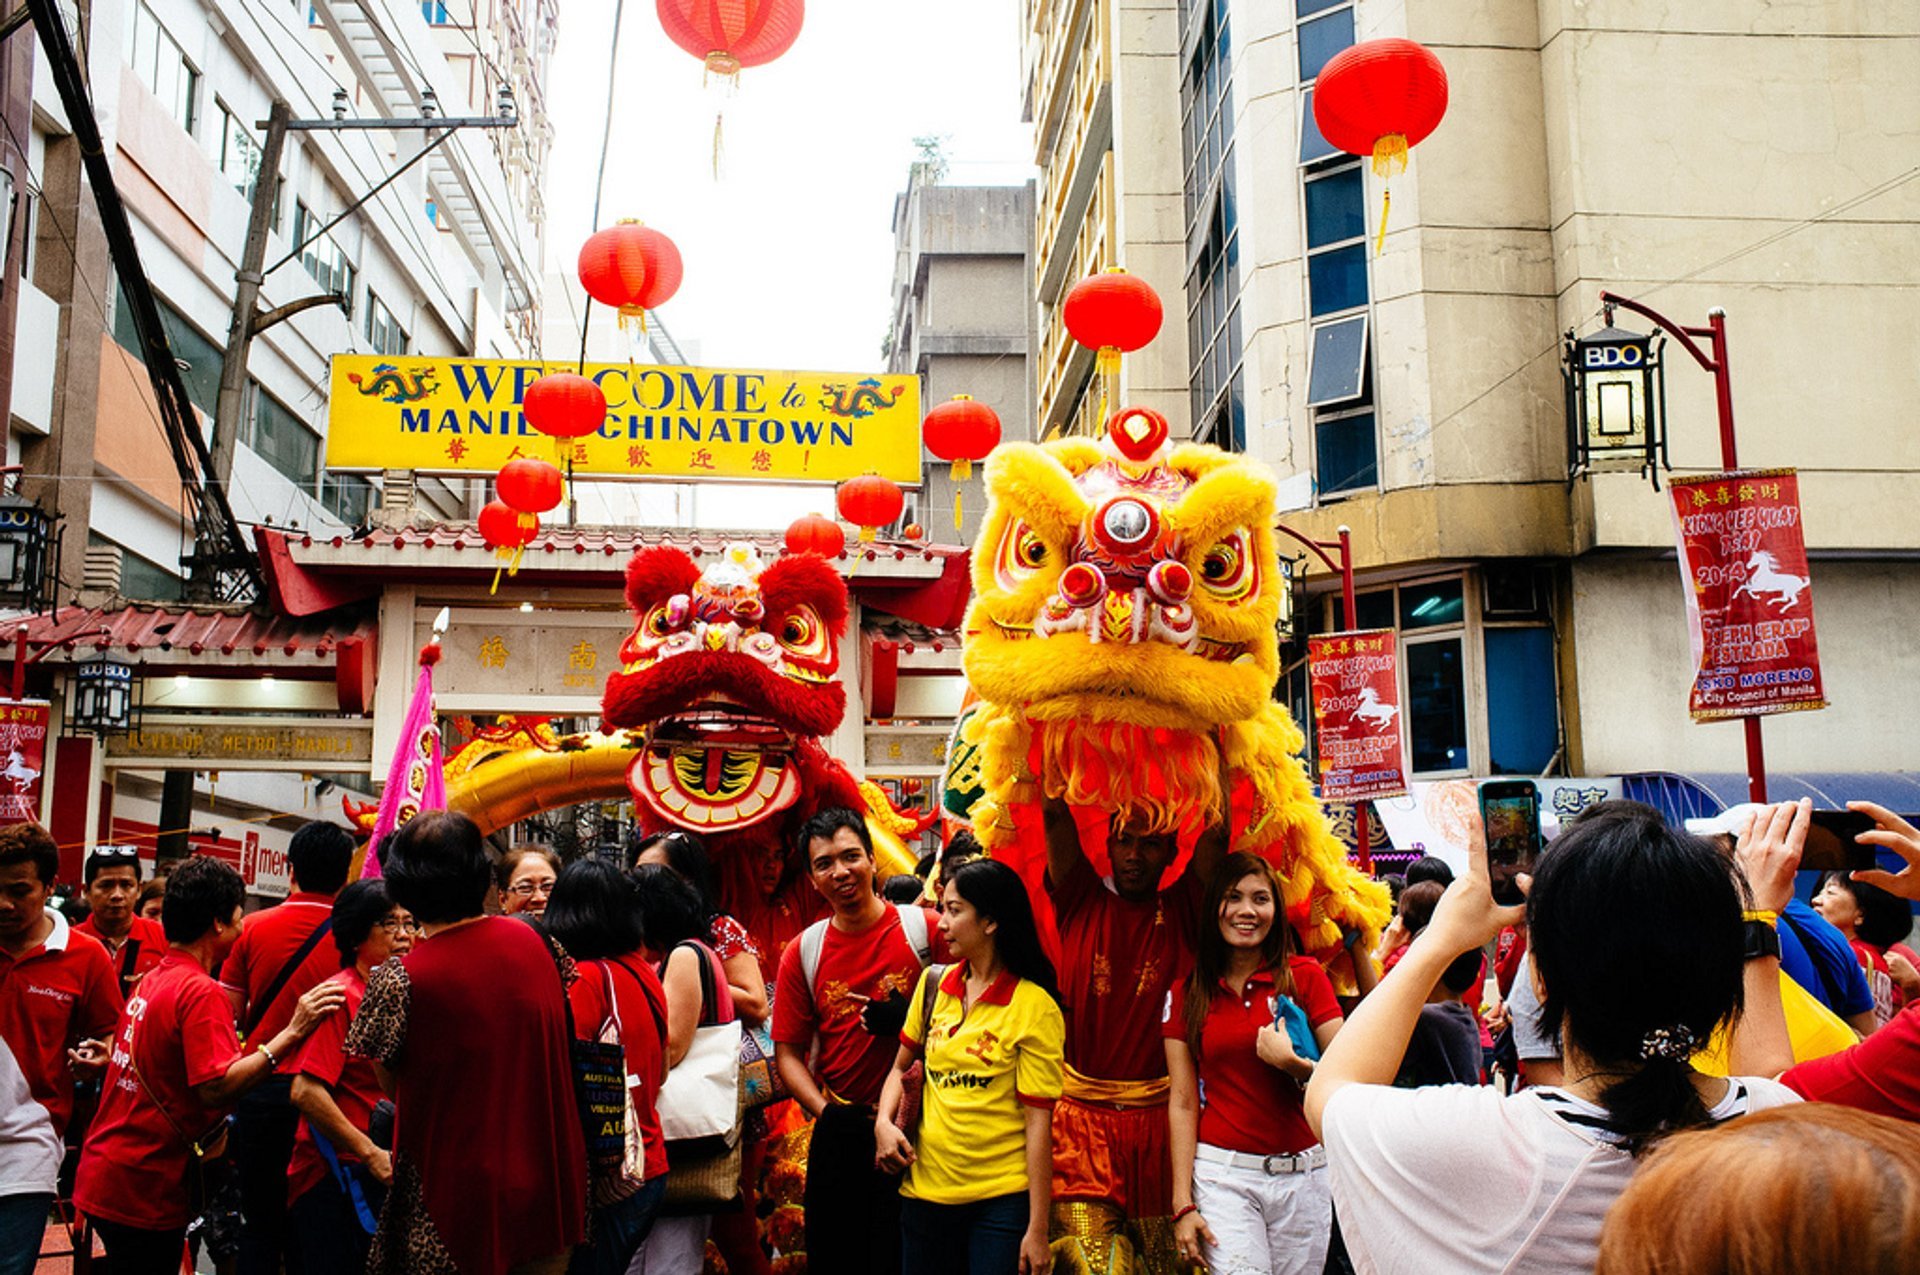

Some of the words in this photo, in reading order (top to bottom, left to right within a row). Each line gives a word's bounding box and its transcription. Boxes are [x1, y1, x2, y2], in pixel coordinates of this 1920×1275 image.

[1585, 345, 1642, 367] BDO
[450, 364, 768, 414] WECOME
[778, 382, 807, 409] to
[401, 408, 548, 437] MANIL
[597, 413, 853, 447] CHINATOWN
[0, 511, 30, 526] DO
[1697, 560, 1747, 587] 2014
[1712, 639, 1790, 666] ESTRADA
[105, 664, 131, 679] BDO
[1696, 676, 1736, 690] ISKO
[1740, 666, 1814, 687] MORENO
[1704, 692, 1725, 705] City
[1726, 689, 1766, 703] Council
[1767, 686, 1779, 699] of
[1781, 684, 1816, 697] Manila
[222, 734, 276, 752] METRO
[295, 735, 353, 753] MANILA
